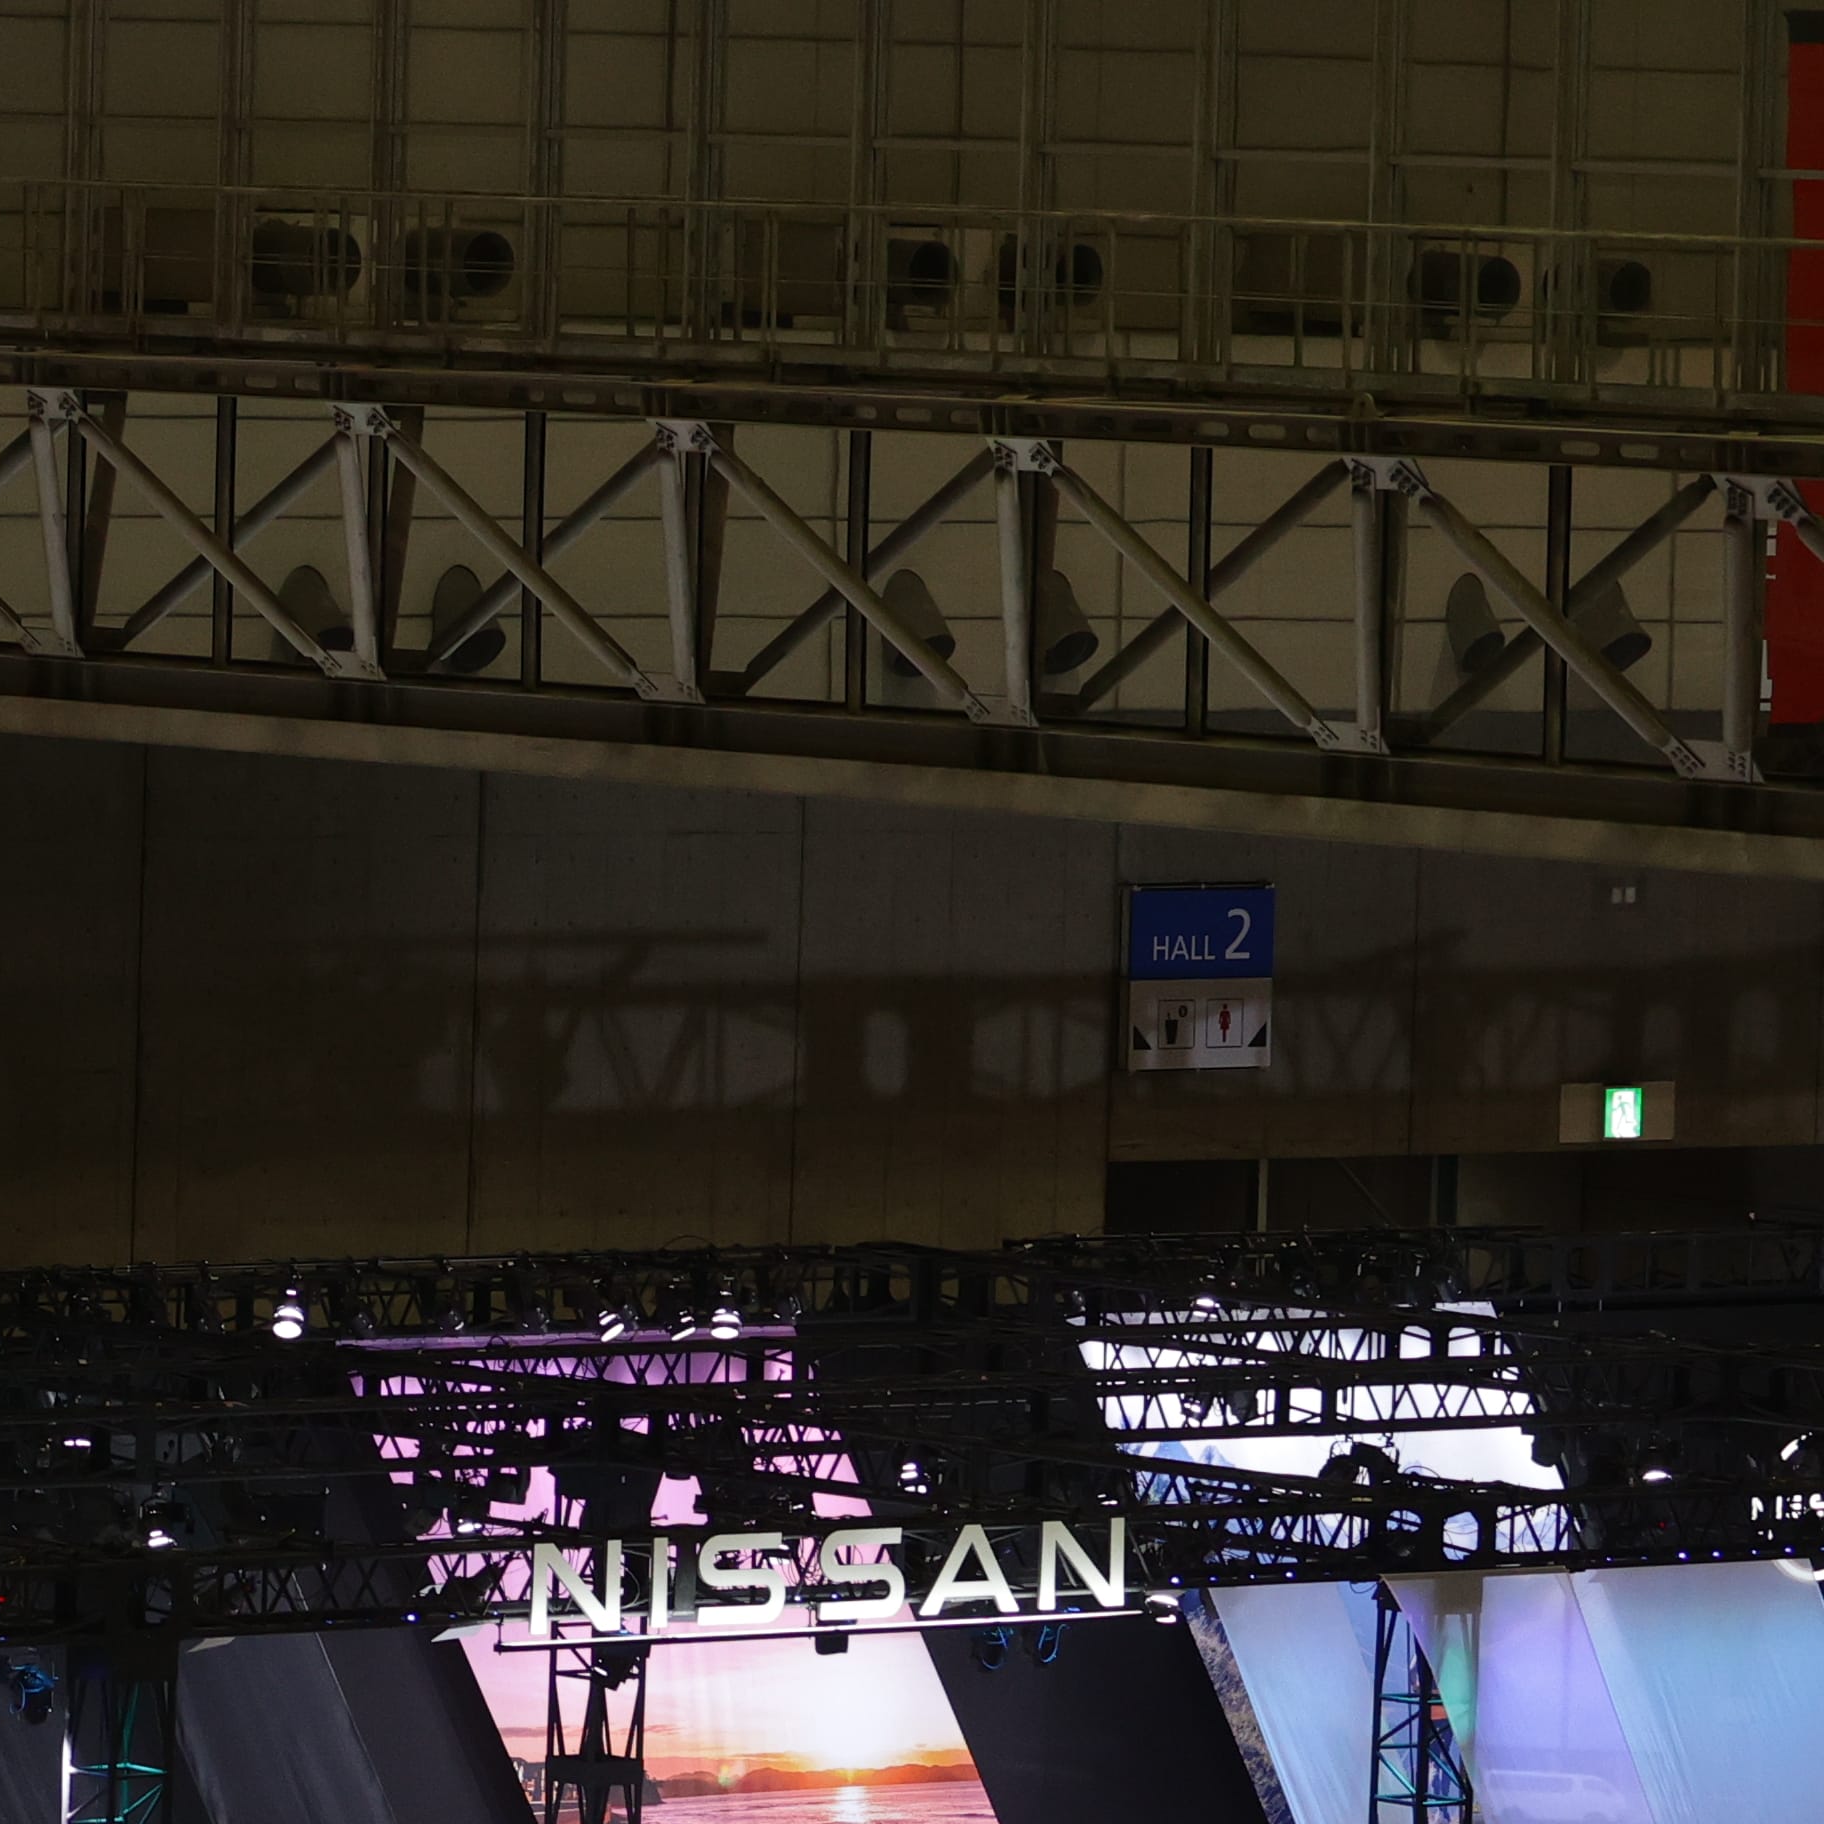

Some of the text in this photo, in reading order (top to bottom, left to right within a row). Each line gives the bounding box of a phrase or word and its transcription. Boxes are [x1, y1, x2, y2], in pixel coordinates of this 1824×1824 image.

[1152, 908, 1251, 962] HALL 2
[529, 1517, 1126, 1635] NISSAN
